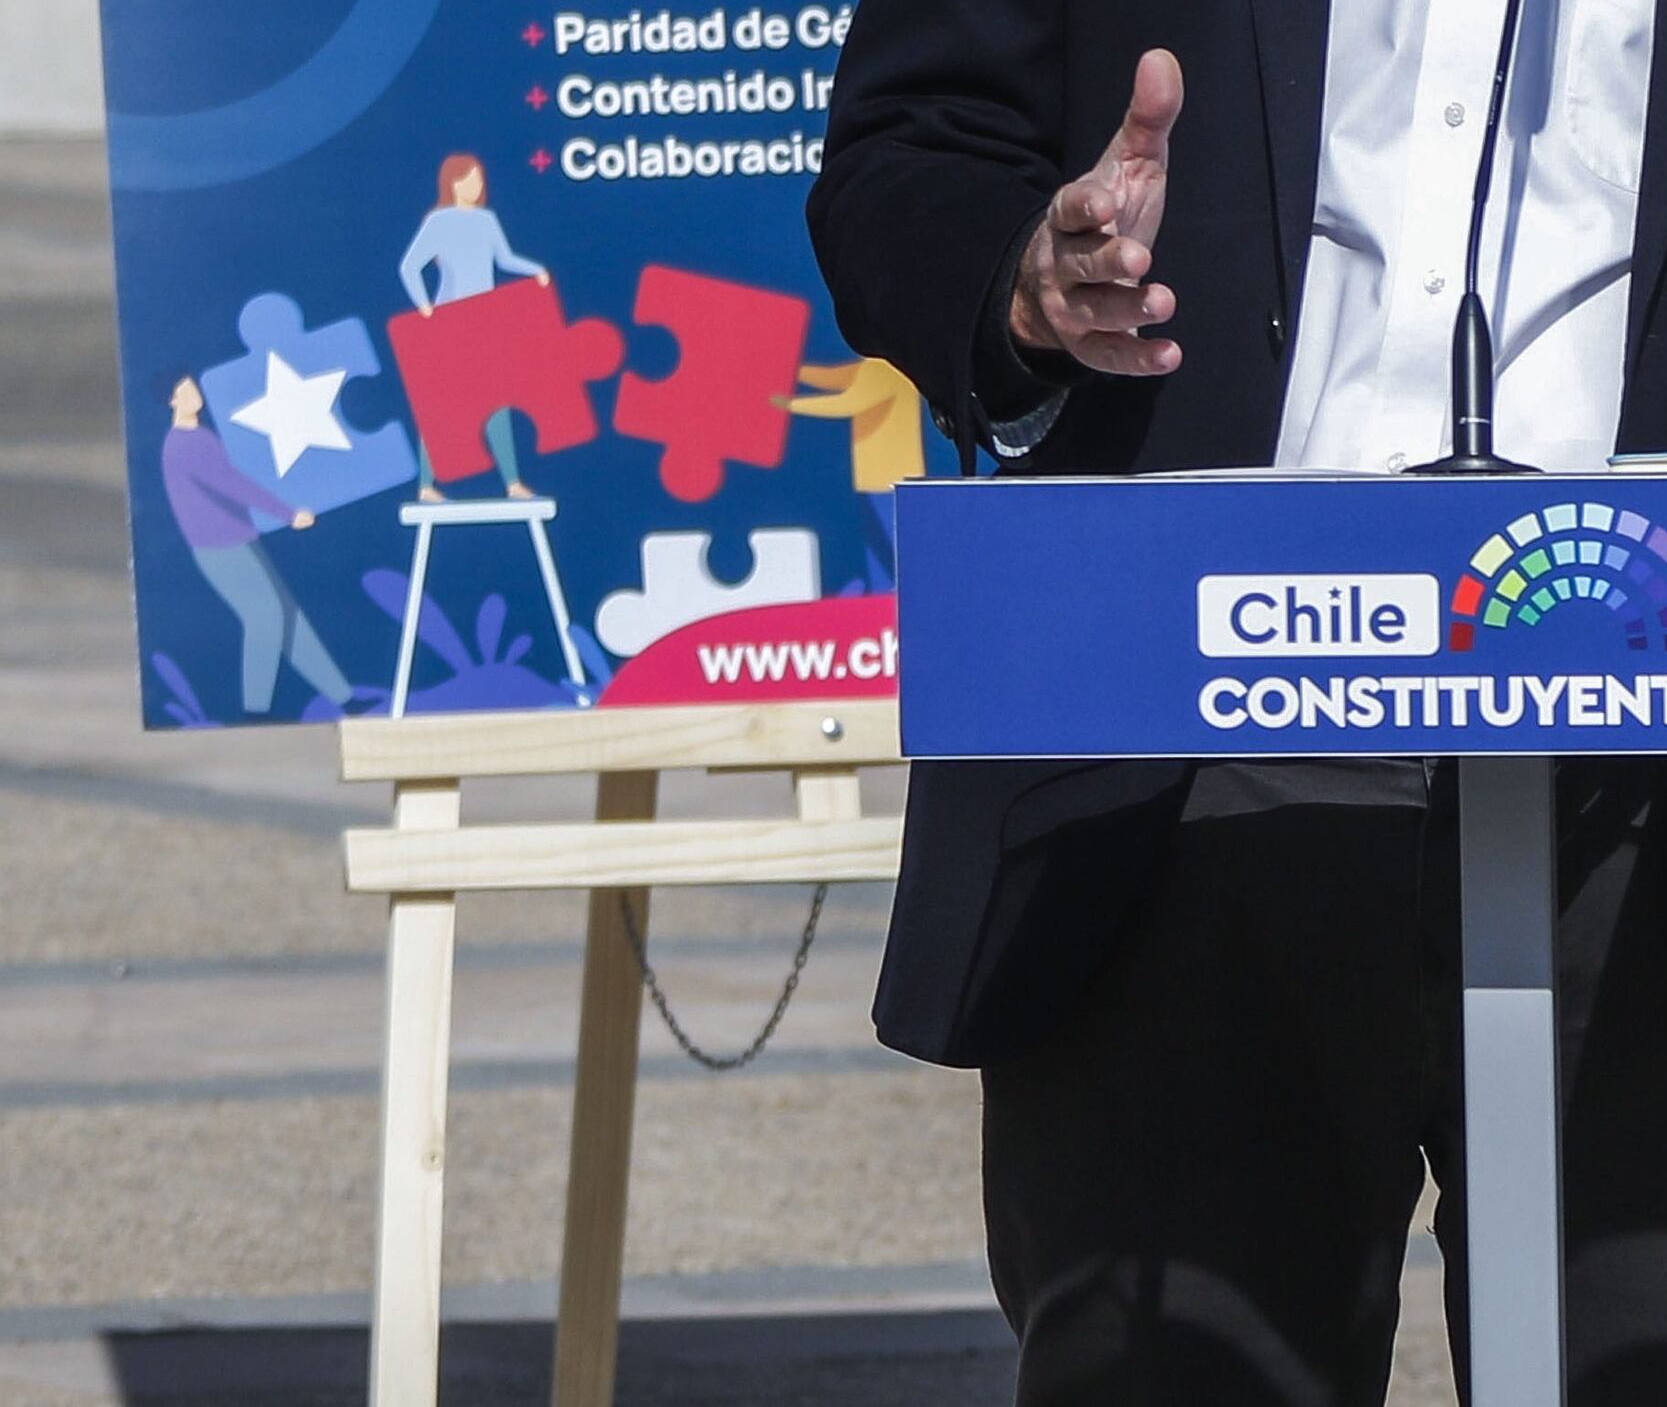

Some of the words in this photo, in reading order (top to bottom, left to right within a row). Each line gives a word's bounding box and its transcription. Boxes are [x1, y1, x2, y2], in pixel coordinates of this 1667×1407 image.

[554, 9, 727, 55] Paridad
[733, 7, 790, 51] de
[557, 71, 795, 119] Contenido
[1231, 585, 1406, 645] Chile
